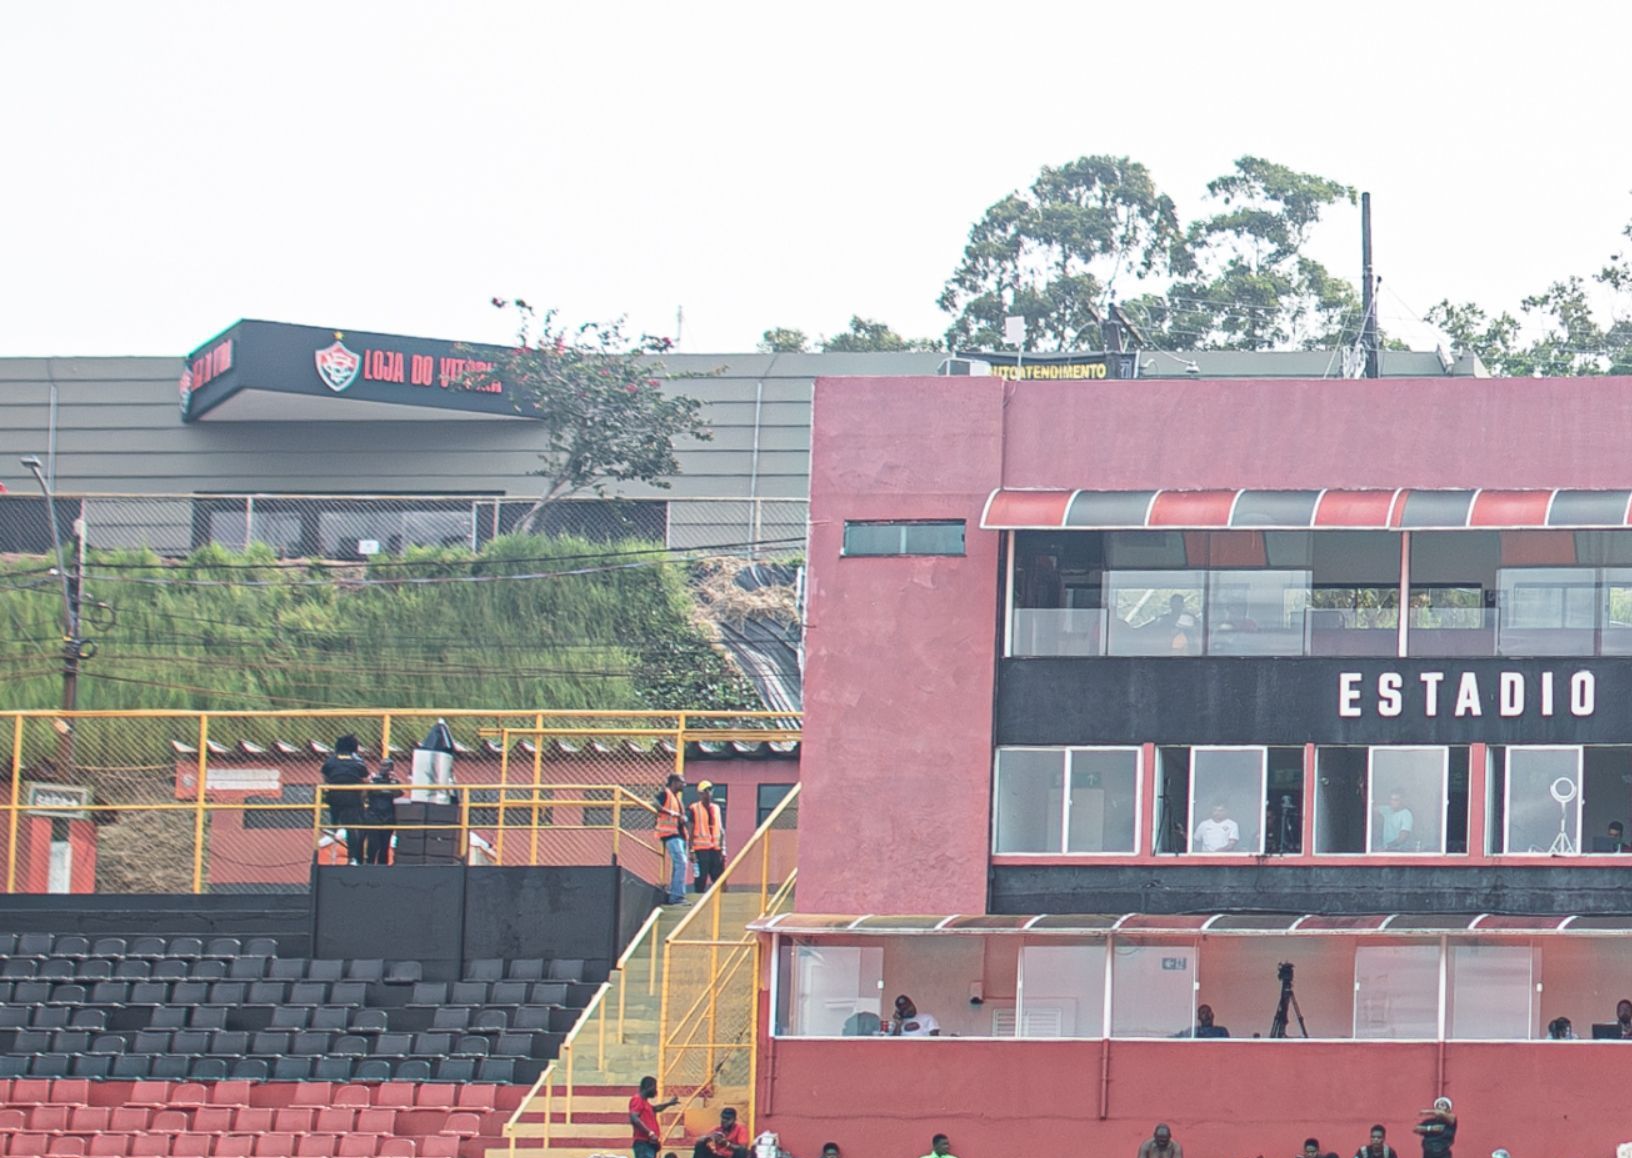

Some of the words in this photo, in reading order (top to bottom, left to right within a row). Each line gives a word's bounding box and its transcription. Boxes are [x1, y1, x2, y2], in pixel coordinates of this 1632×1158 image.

[363, 348, 404, 383] LOJA
[411, 353, 433, 386] DO
[990, 363, 1106, 380] UTOATENDIMENTO
[1338, 670, 1597, 717] ESTADIO
